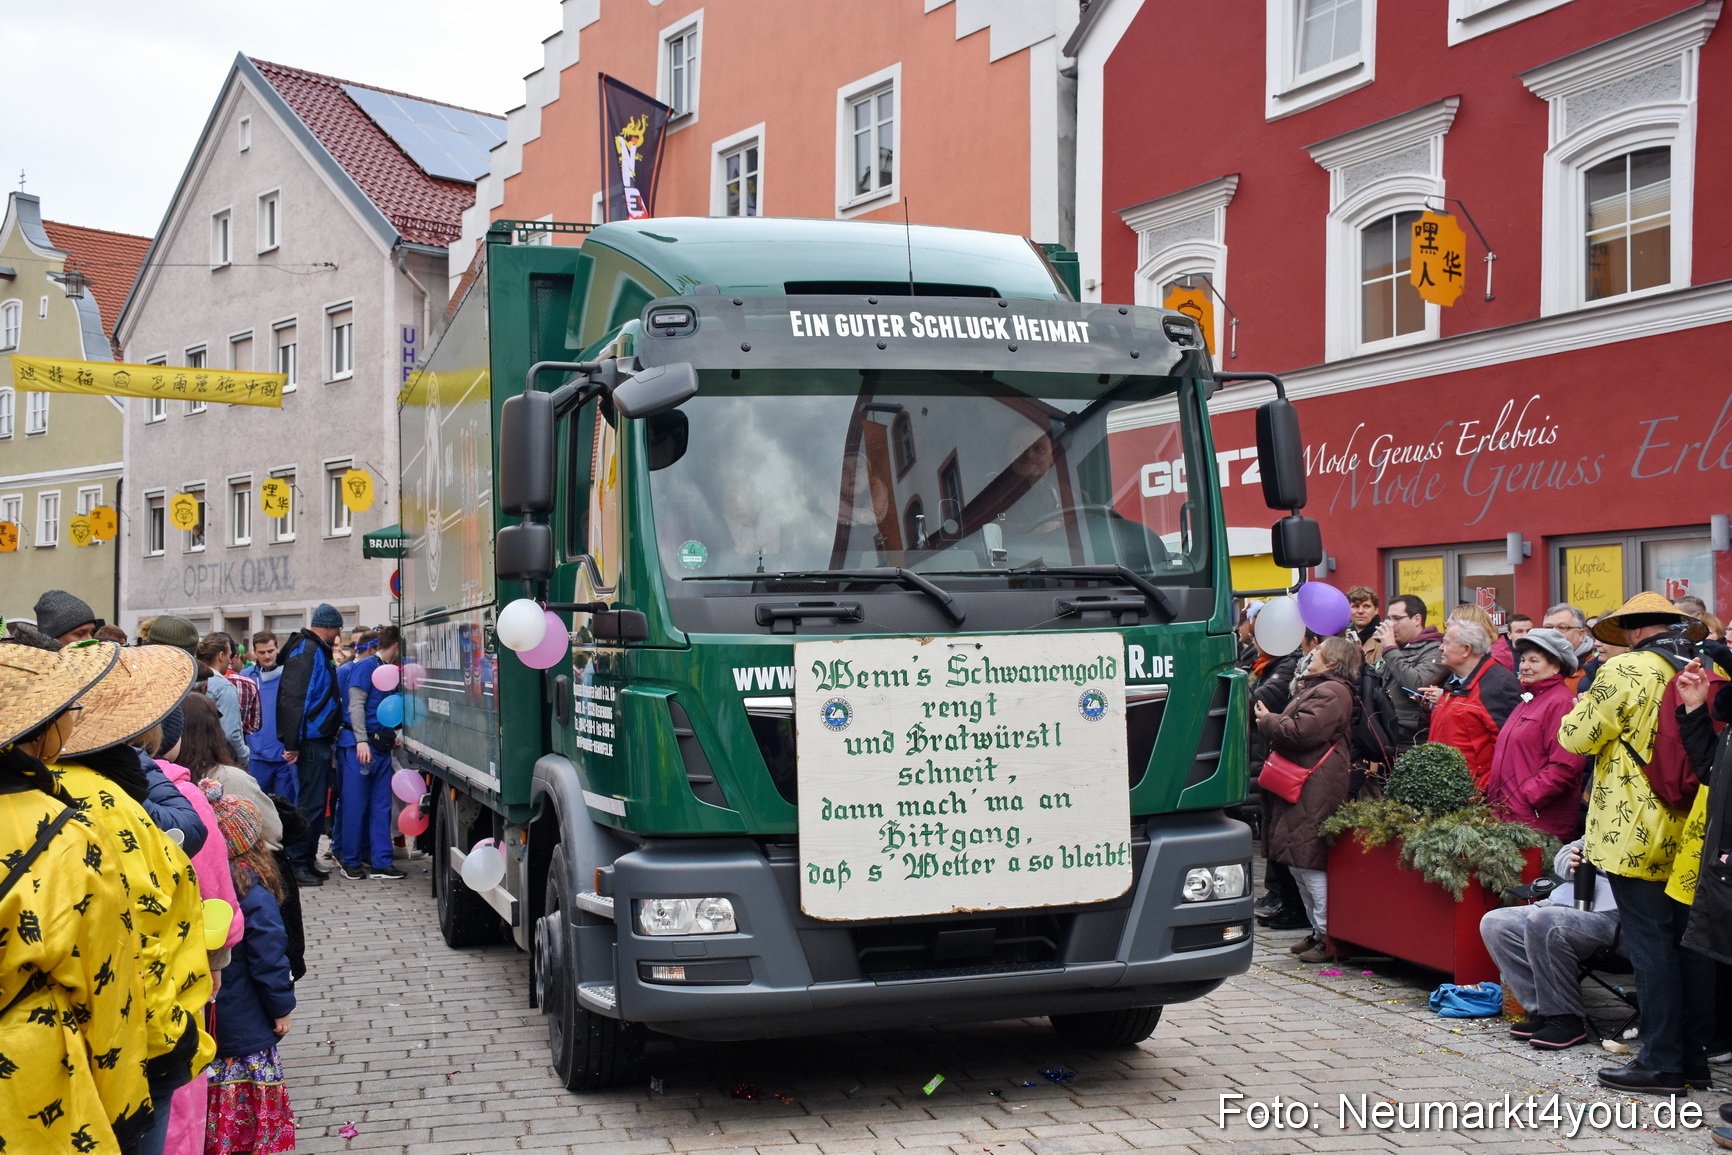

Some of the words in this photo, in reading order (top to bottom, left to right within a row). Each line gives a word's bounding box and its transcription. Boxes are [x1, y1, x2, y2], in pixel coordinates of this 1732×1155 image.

[1303, 423, 1364, 477] Mode
[1368, 433, 1444, 484] Genuss
[1455, 394, 1559, 456] Erlebnis
[1330, 420, 1454, 516] Mode
[1463, 439, 1606, 526] Genuss
[369, 538, 399, 549] BRAU
[183, 561, 237, 597] OPTIK
[240, 554, 296, 593] OEXL
[1572, 582, 1606, 602] Kaffee
[811, 655, 932, 692] Wenn's
[945, 653, 1118, 688] Schwanengold
[921, 692, 998, 723] rengt
[843, 730, 895, 755] und
[905, 721, 1061, 756] Bratwürstl
[821, 797, 884, 821] dann
[983, 793, 1024, 812] ma
[1038, 791, 1073, 810] an
[806, 859, 851, 894] daß
[903, 852, 996, 881] Wetter
[1058, 842, 1132, 870] bleibt!
